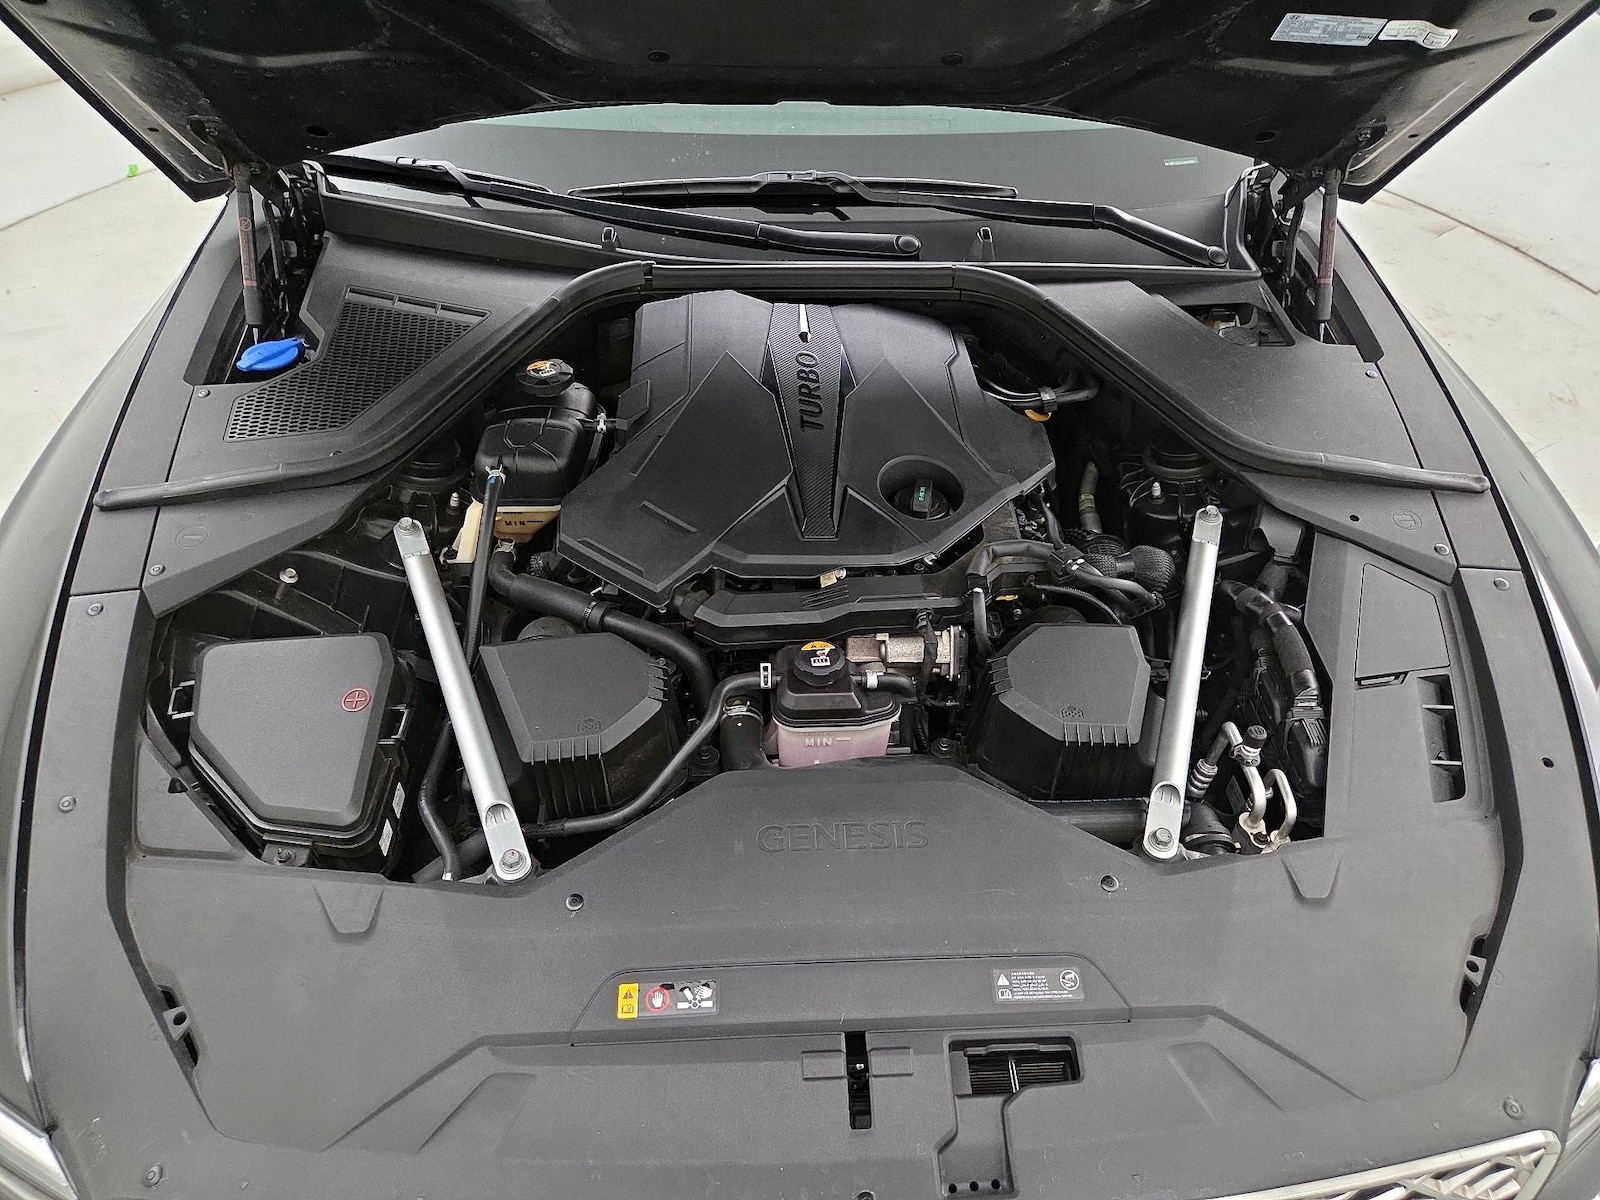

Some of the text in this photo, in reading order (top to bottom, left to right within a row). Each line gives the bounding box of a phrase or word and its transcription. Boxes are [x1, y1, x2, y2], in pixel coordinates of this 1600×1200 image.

[796, 351, 823, 431] TURBO
[805, 737, 832, 747] MIN
[756, 820, 929, 853] GENESIS
